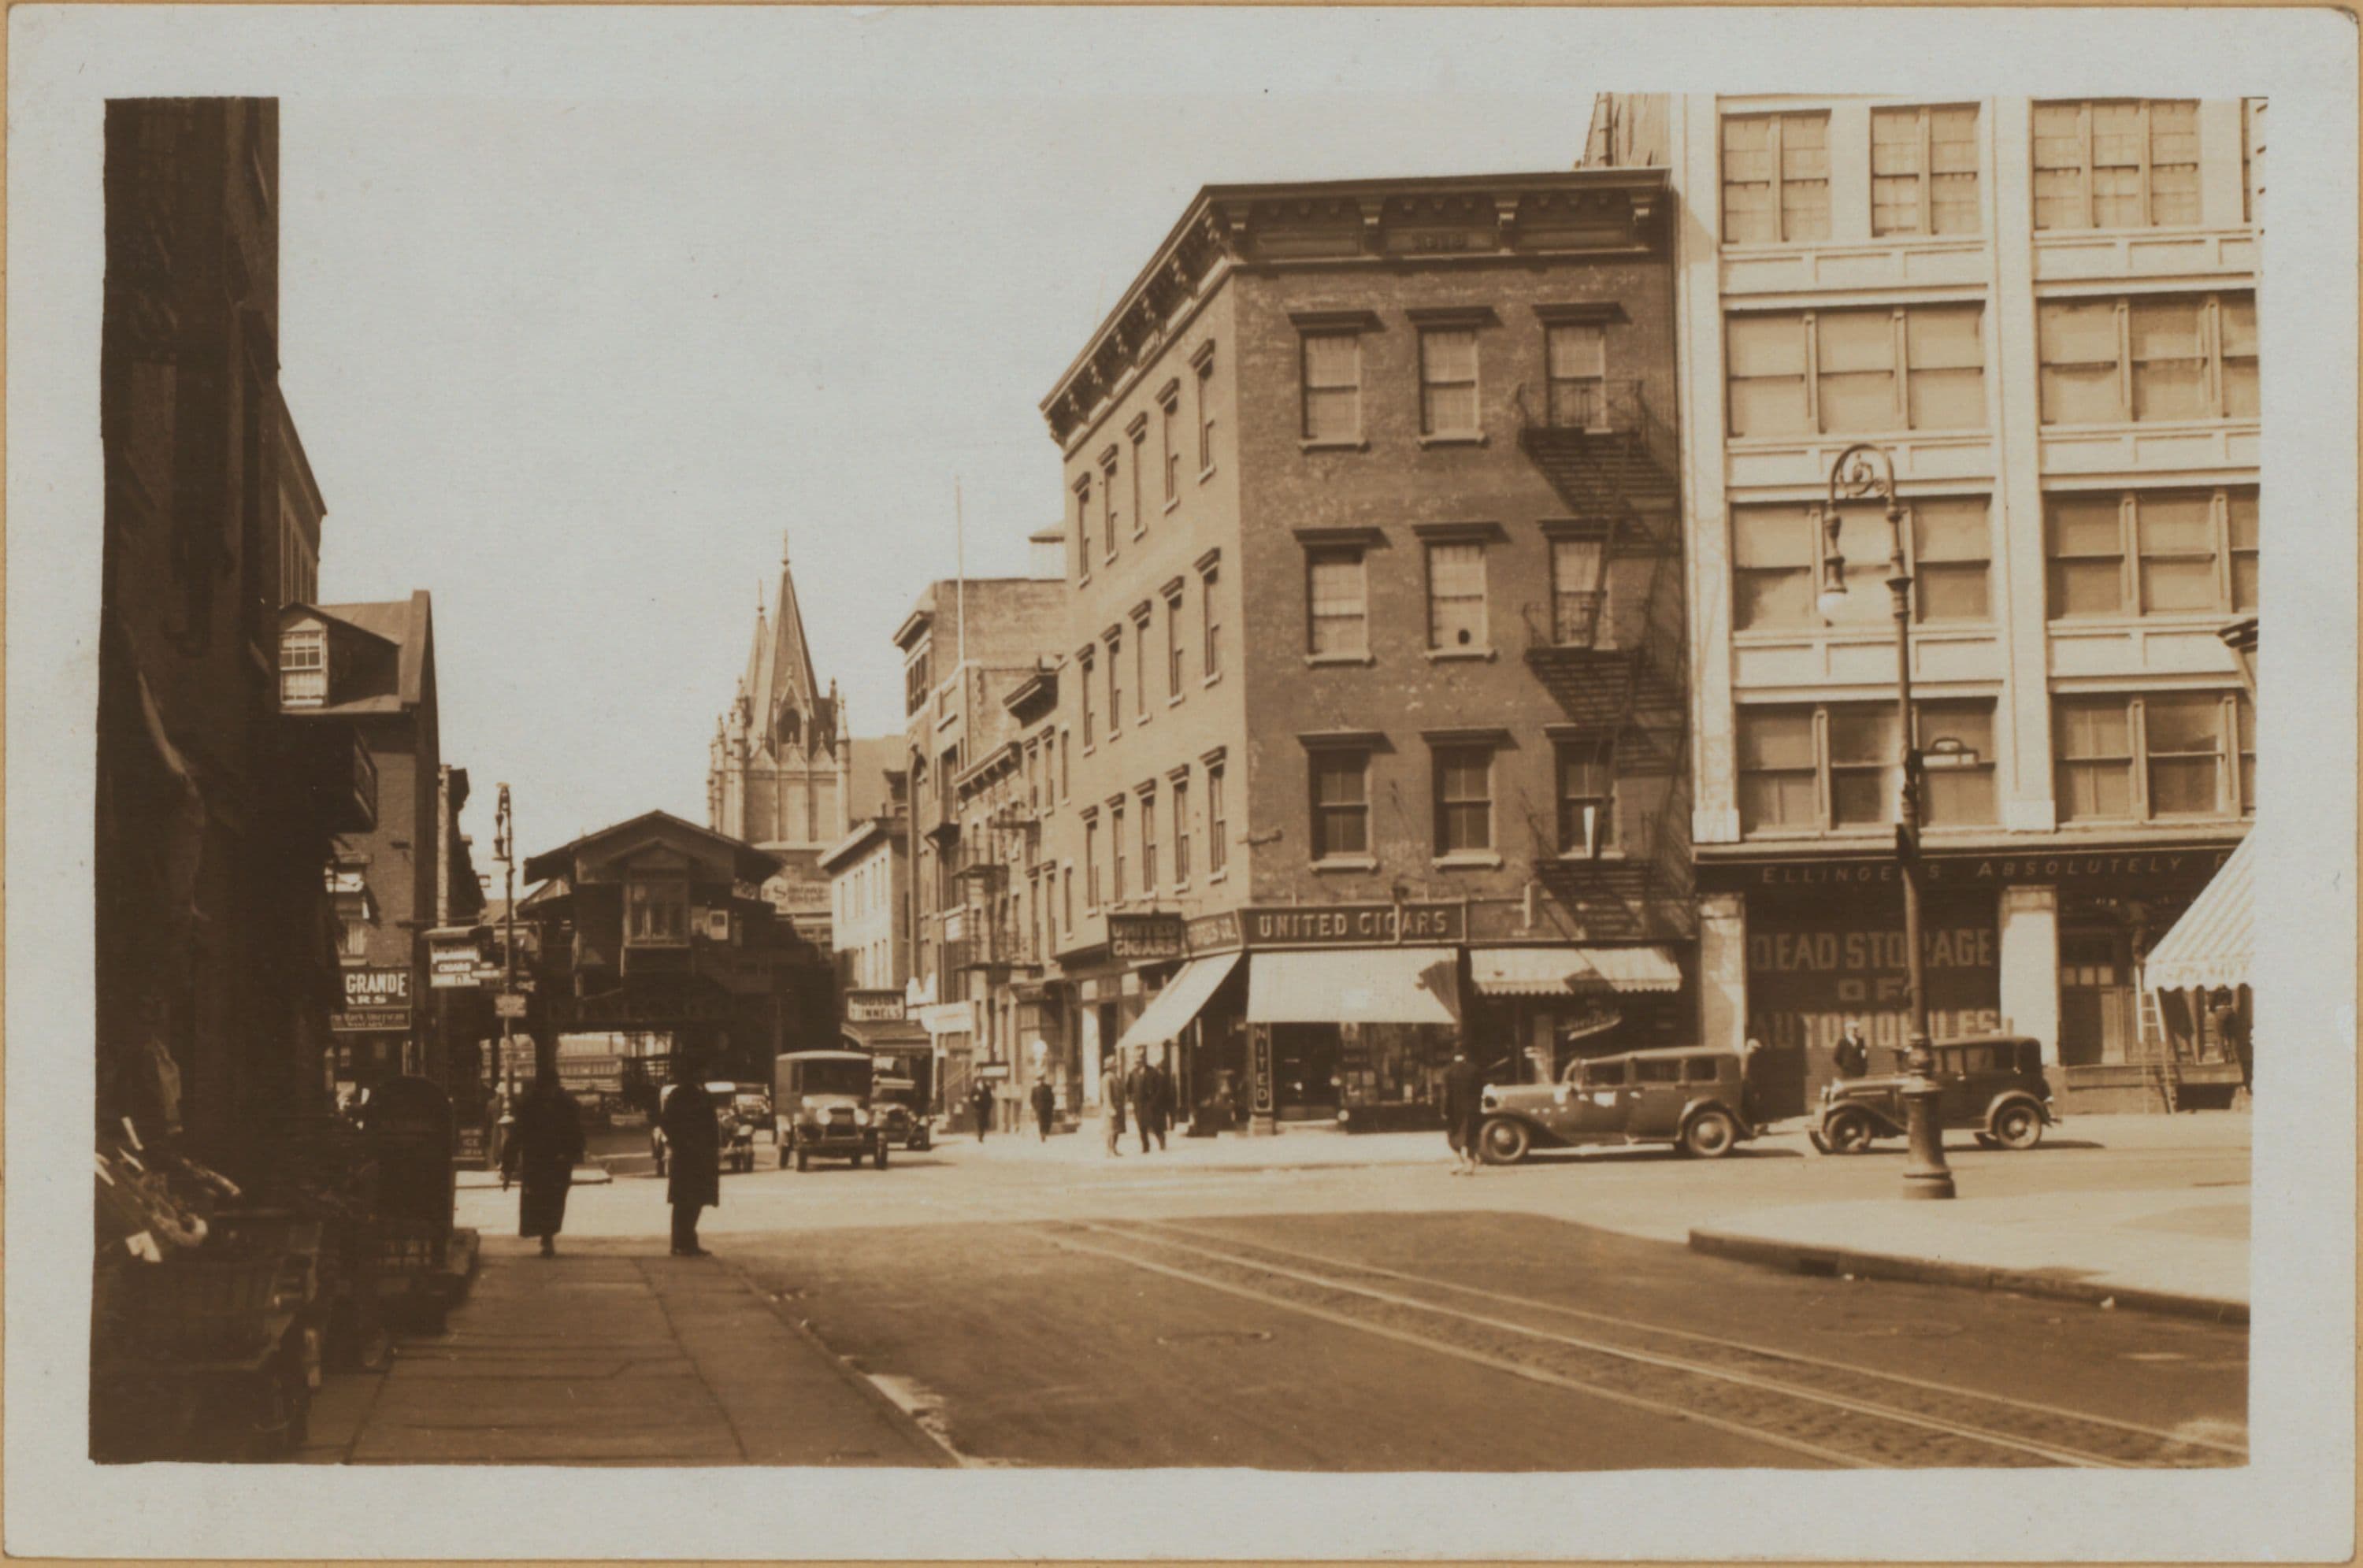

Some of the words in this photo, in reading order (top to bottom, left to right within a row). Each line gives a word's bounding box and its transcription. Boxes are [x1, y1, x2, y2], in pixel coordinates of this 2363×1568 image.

[1978, 856, 2183, 877] ABSOLUTELY
[1111, 921, 1178, 939] UNITED
[1259, 913, 1348, 938] UNITED
[1358, 910, 1446, 935] CIGARS
[1112, 939, 1178, 957] CIGARS
[1749, 932, 1838, 971] DEAD
[346, 973, 407, 997] GRANDE
[1838, 977, 1905, 1002] OF
[1256, 1026, 1268, 1102] NITED
